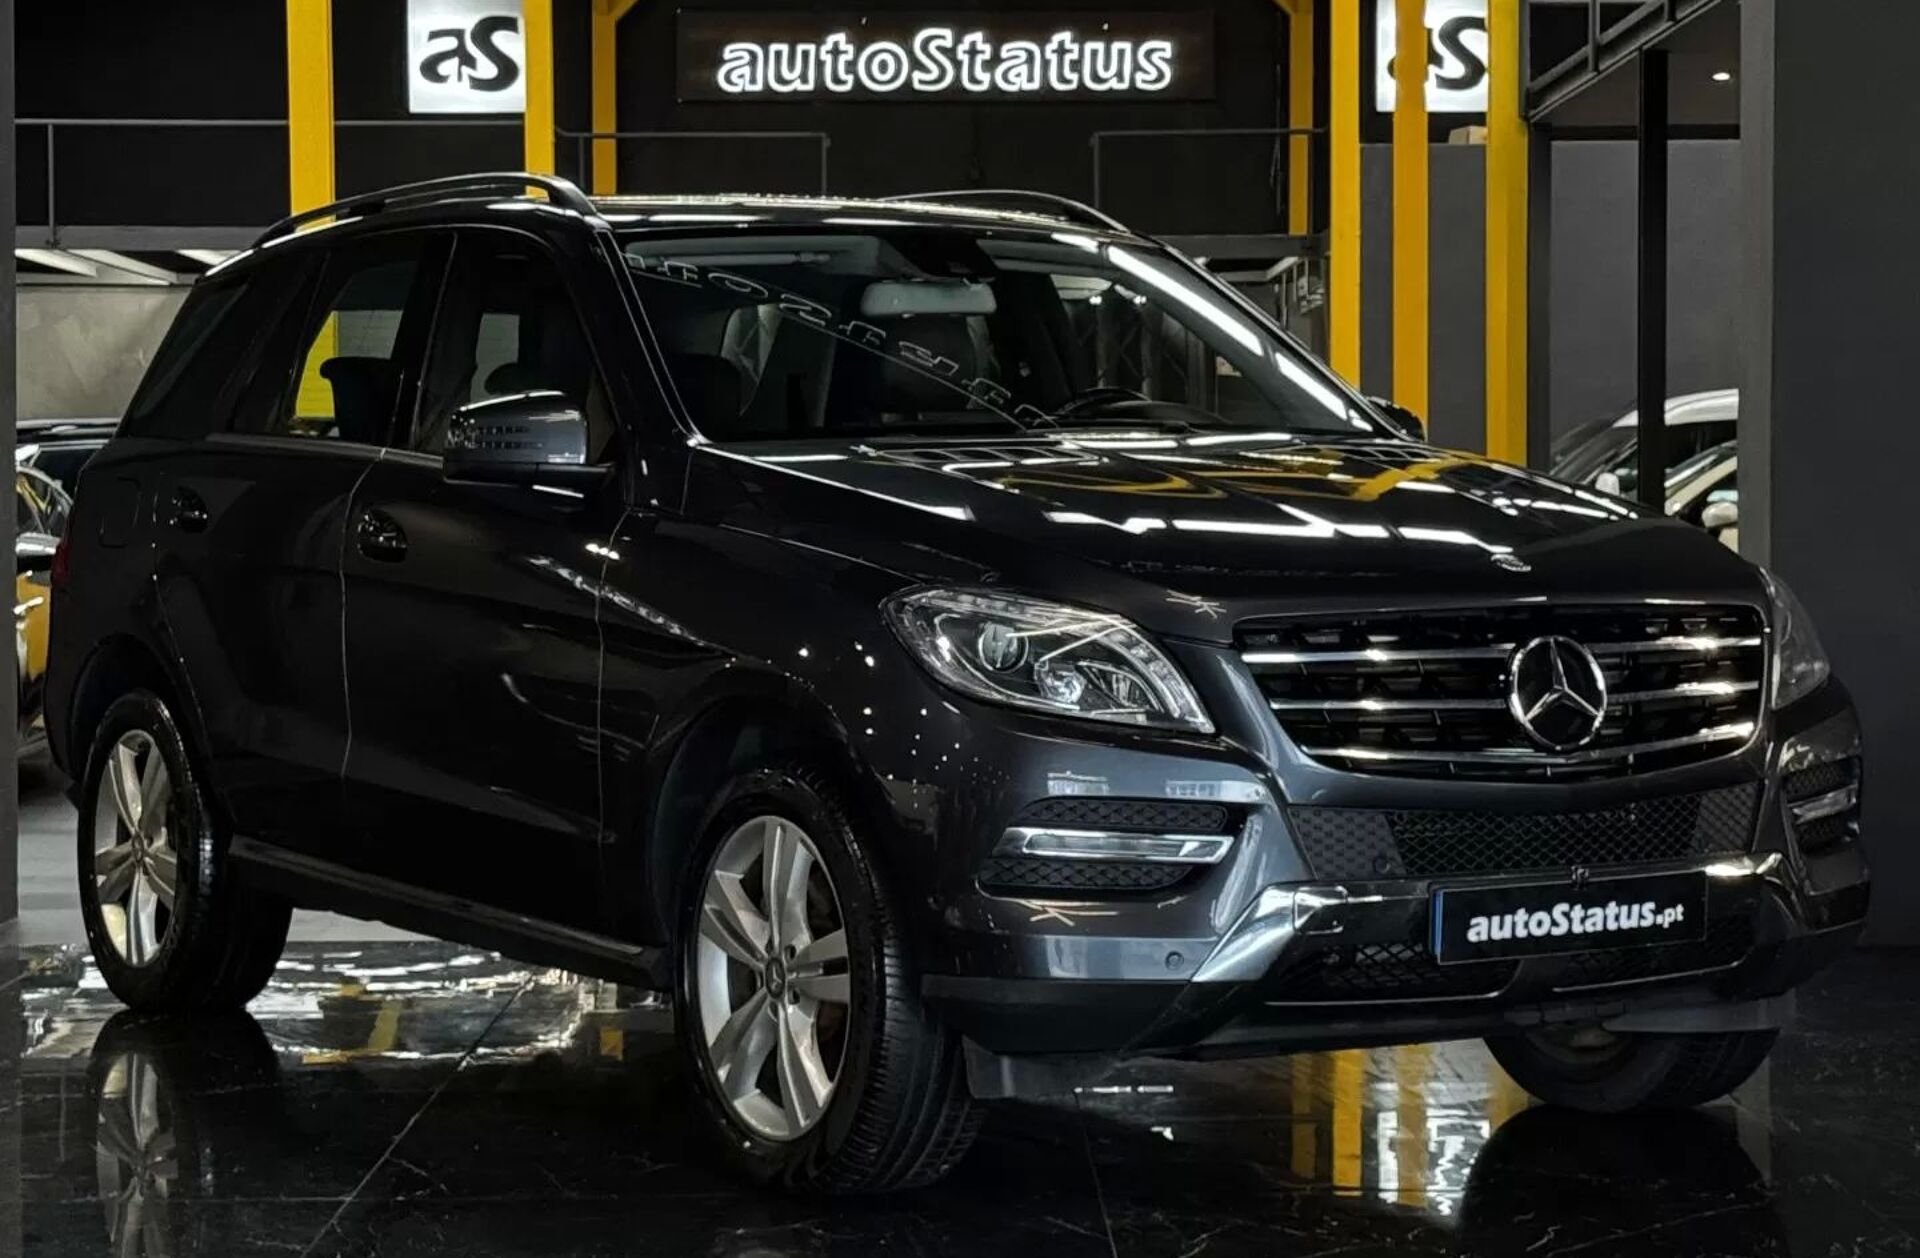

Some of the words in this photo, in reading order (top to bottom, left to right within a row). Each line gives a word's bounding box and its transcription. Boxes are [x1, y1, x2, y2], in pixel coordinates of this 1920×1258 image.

[419, 16, 519, 92] aS
[716, 28, 1174, 92] autoStatus
[1467, 901, 1684, 943] autoStatus.pt
